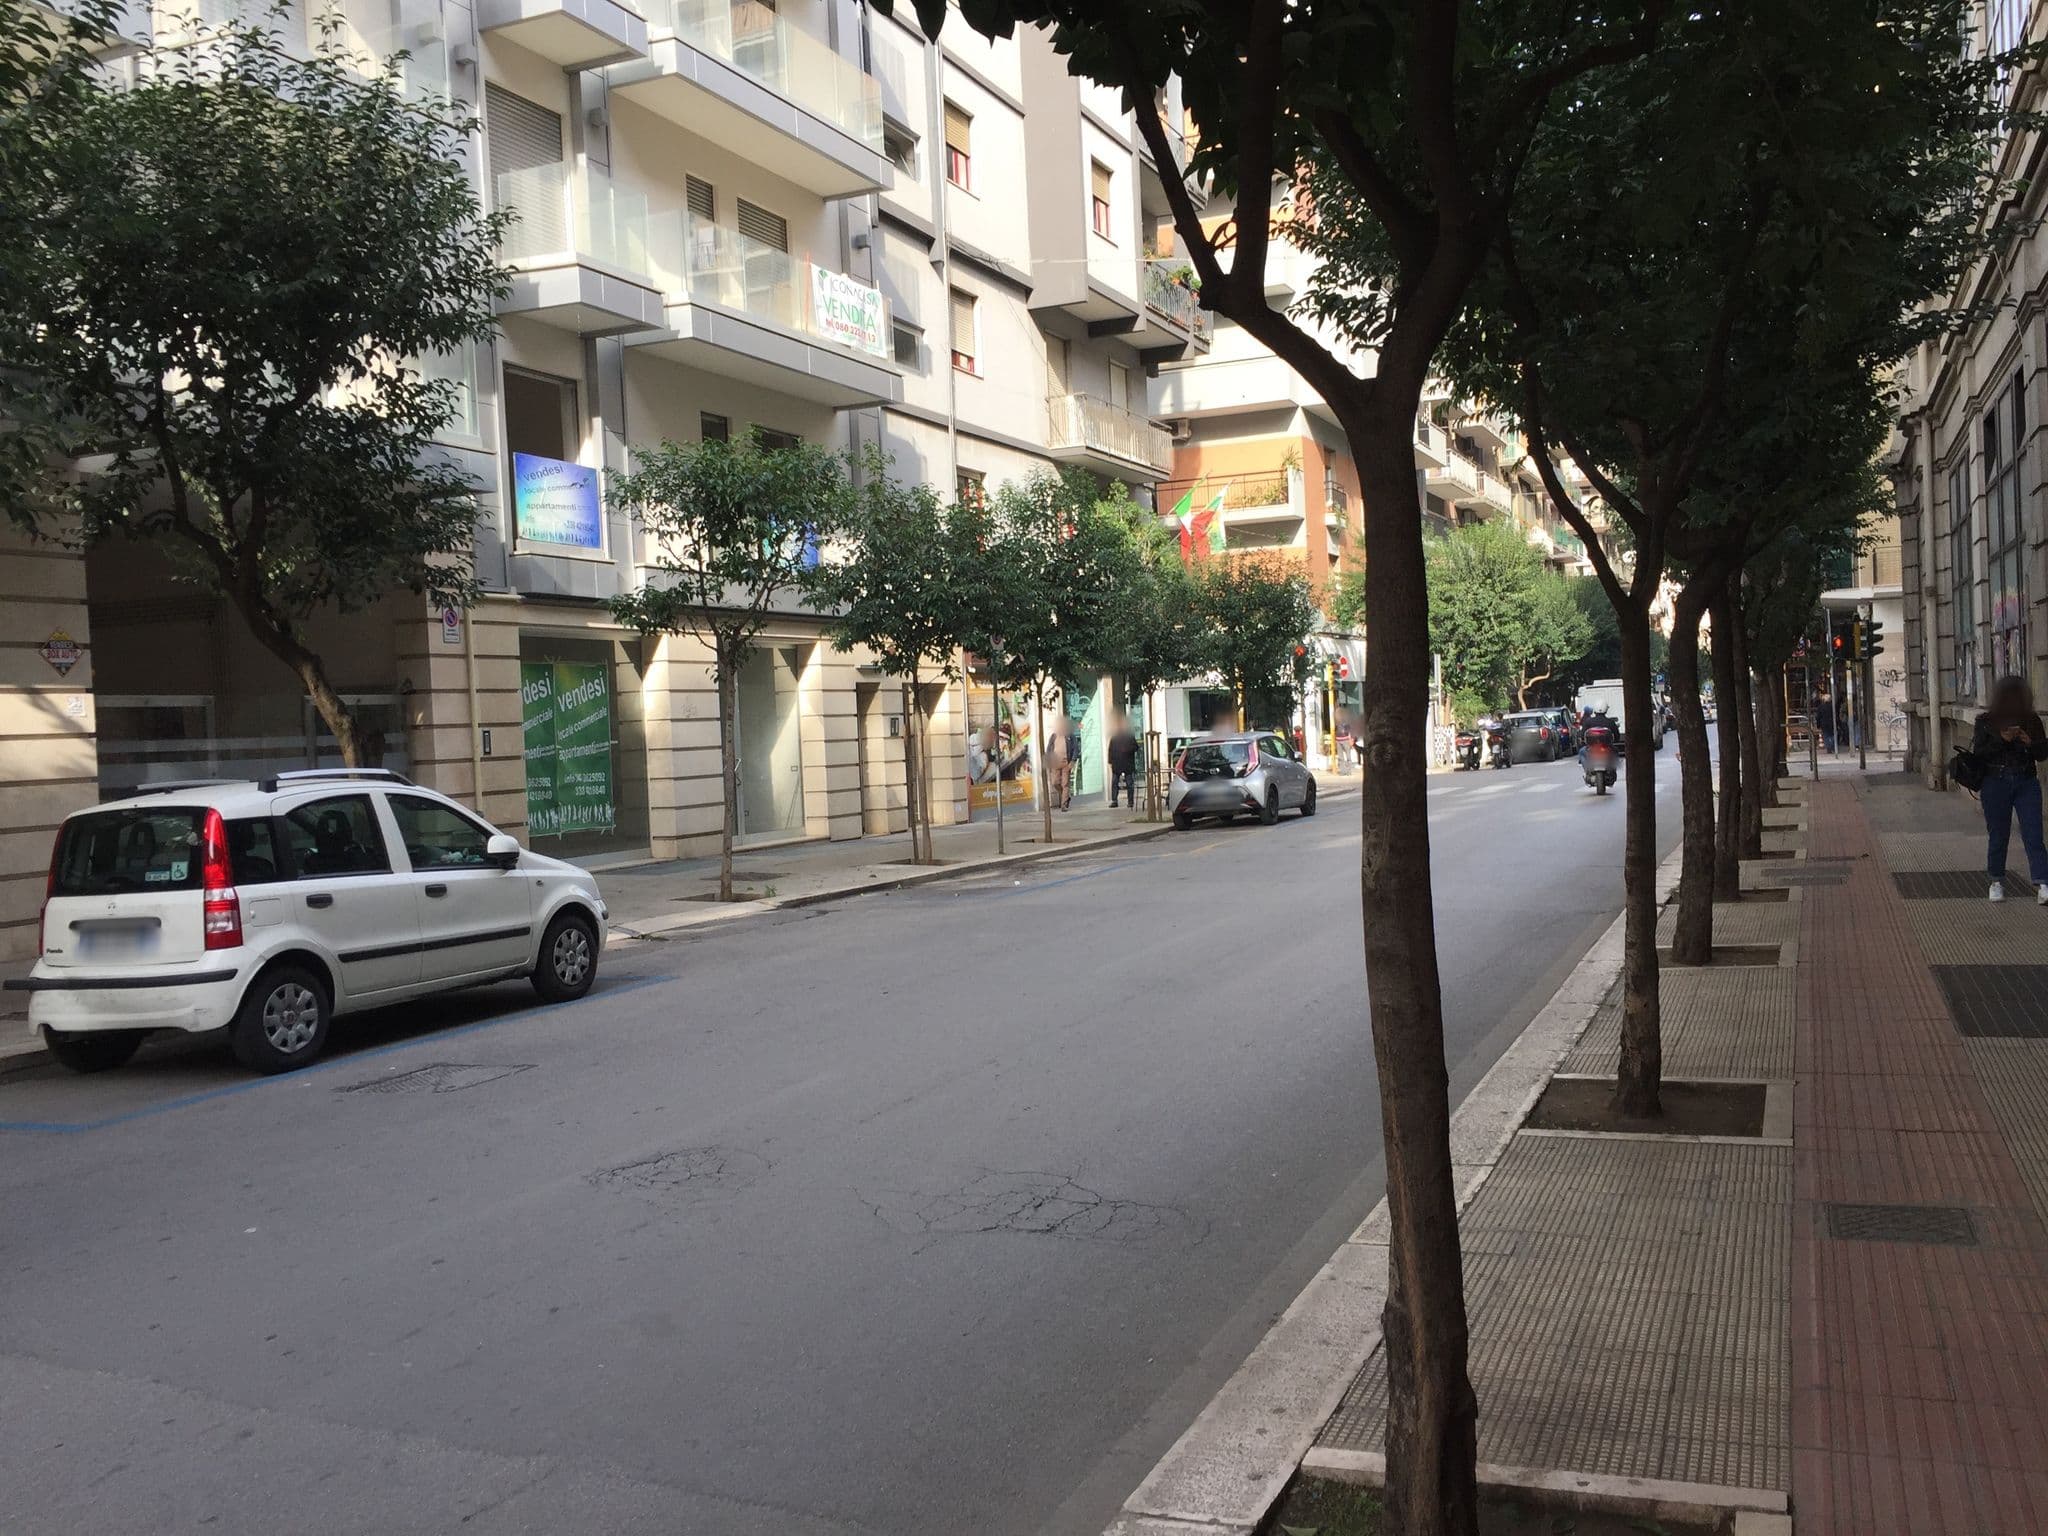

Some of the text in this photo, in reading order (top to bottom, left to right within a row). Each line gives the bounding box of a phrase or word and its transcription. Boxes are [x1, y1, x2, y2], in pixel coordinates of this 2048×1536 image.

[822, 294, 877, 333] VENDITA
[523, 463, 565, 482] vendesi
[557, 671, 606, 712] vendesi
